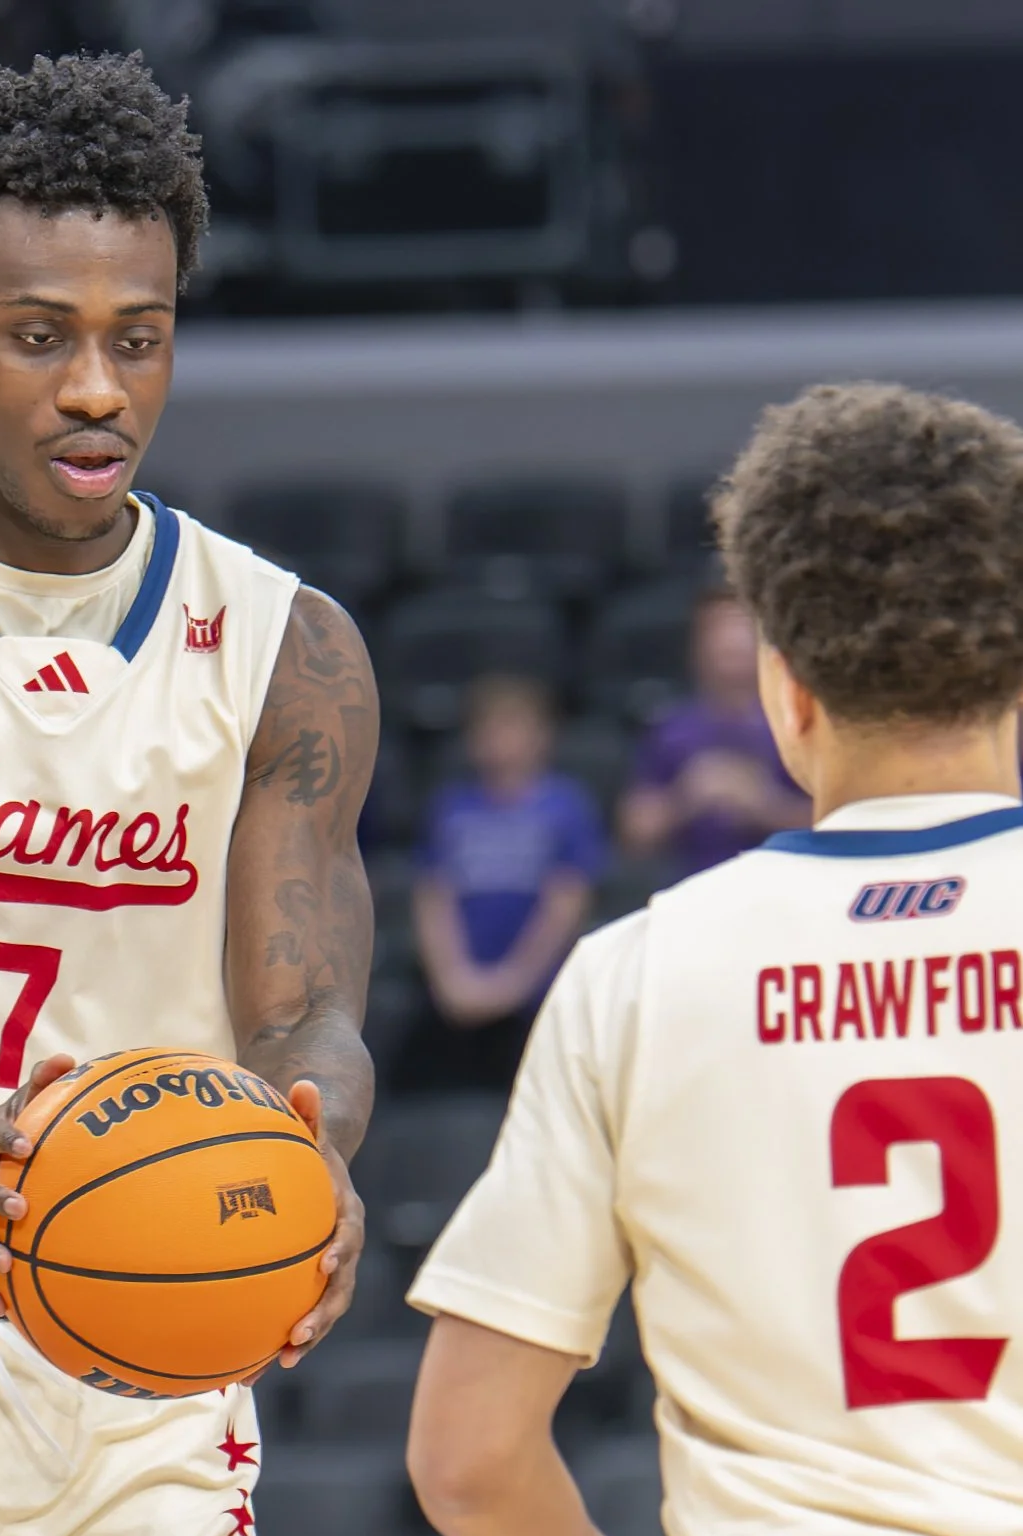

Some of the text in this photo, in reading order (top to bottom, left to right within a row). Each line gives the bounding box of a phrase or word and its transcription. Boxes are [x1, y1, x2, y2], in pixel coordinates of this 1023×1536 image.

[850, 877, 964, 921] UIC
[76, 1067, 299, 1138] Wilson
[830, 1075, 1011, 1411] 2
